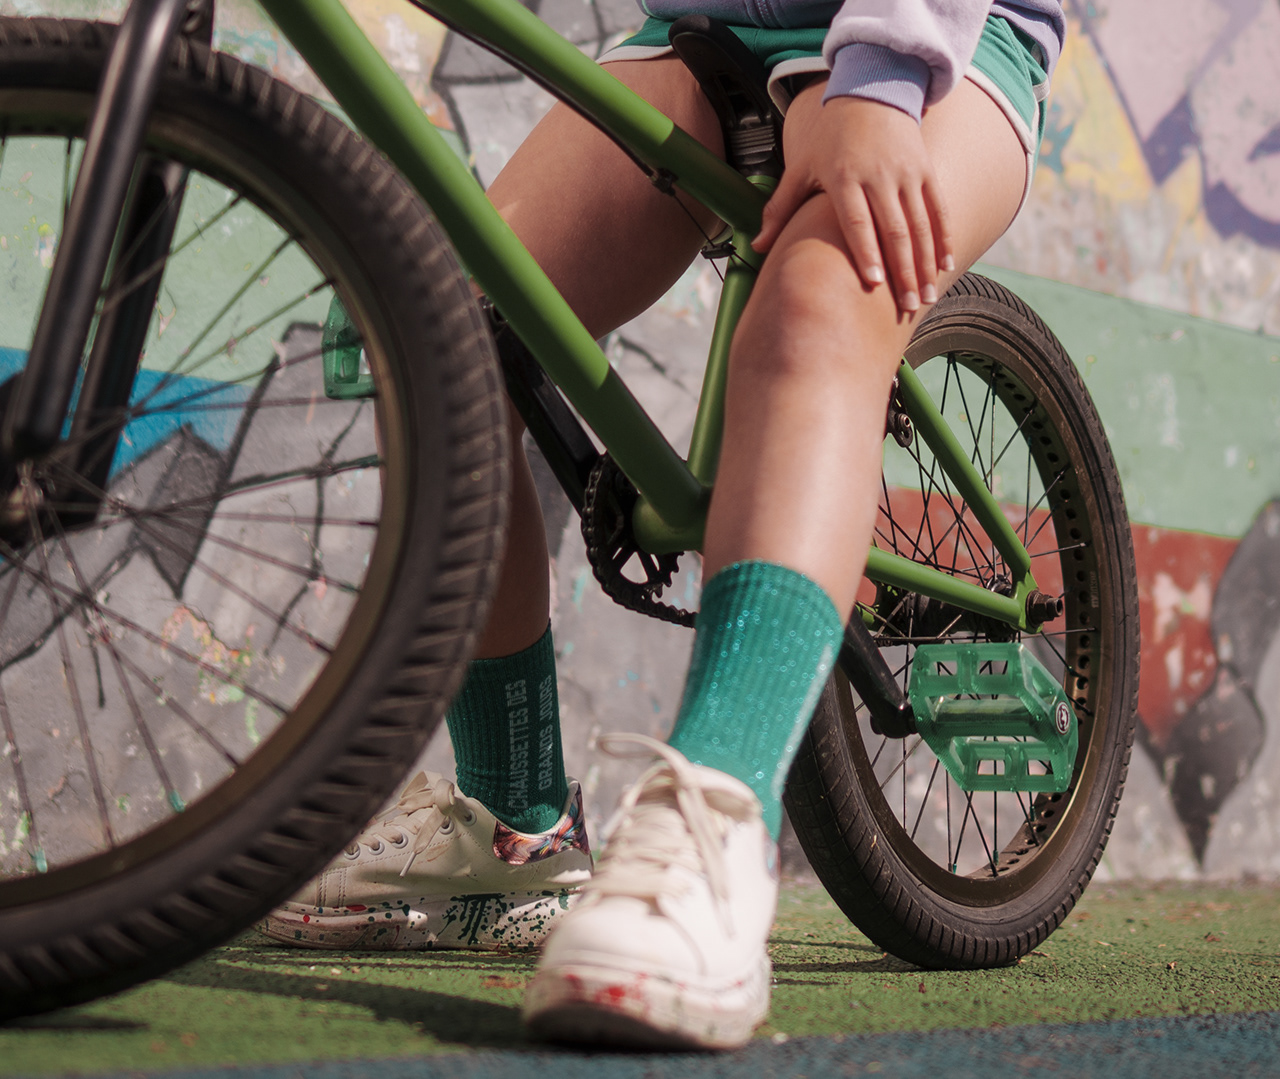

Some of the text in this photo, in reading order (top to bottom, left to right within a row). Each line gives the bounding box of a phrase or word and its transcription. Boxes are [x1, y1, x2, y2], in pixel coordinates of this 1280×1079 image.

[505, 679, 529, 809] CHAUSSETTES DES
[538, 675, 554, 790] GRANDS JOURS
